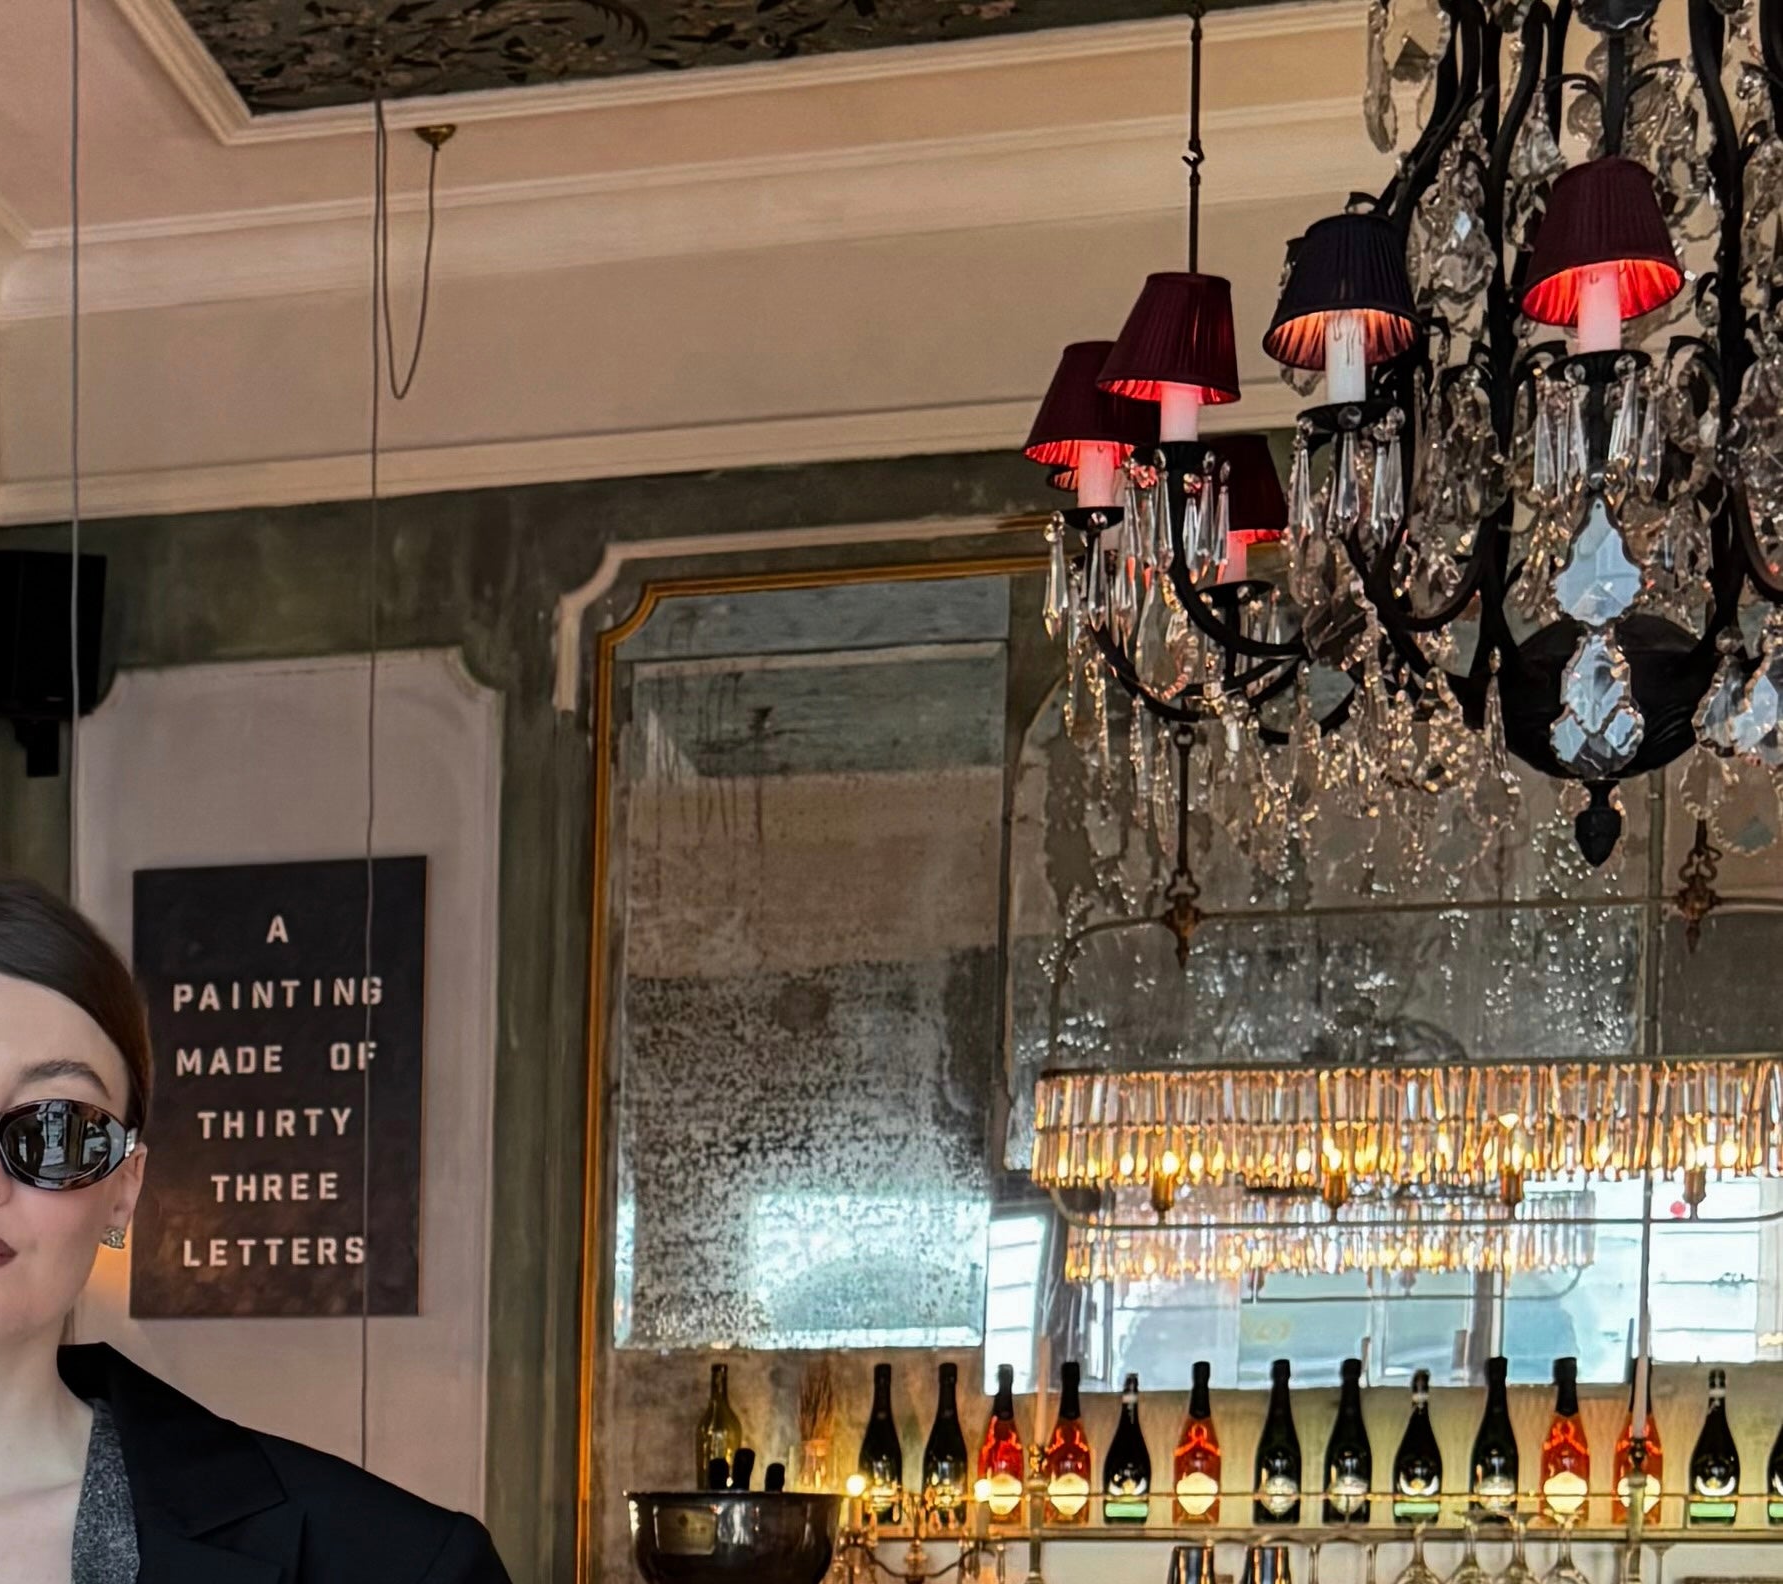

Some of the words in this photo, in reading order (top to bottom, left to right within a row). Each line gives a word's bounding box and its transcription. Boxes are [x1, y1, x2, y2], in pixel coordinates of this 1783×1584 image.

[266, 915, 289, 943] A
[173, 976, 383, 1012] PAINTING
[175, 1045, 283, 1076] MADE
[329, 1041, 378, 1072] OF
[197, 1107, 353, 1140] THIRTY
[210, 1172, 339, 1203] THREE
[182, 1236, 366, 1267] LETTERS
